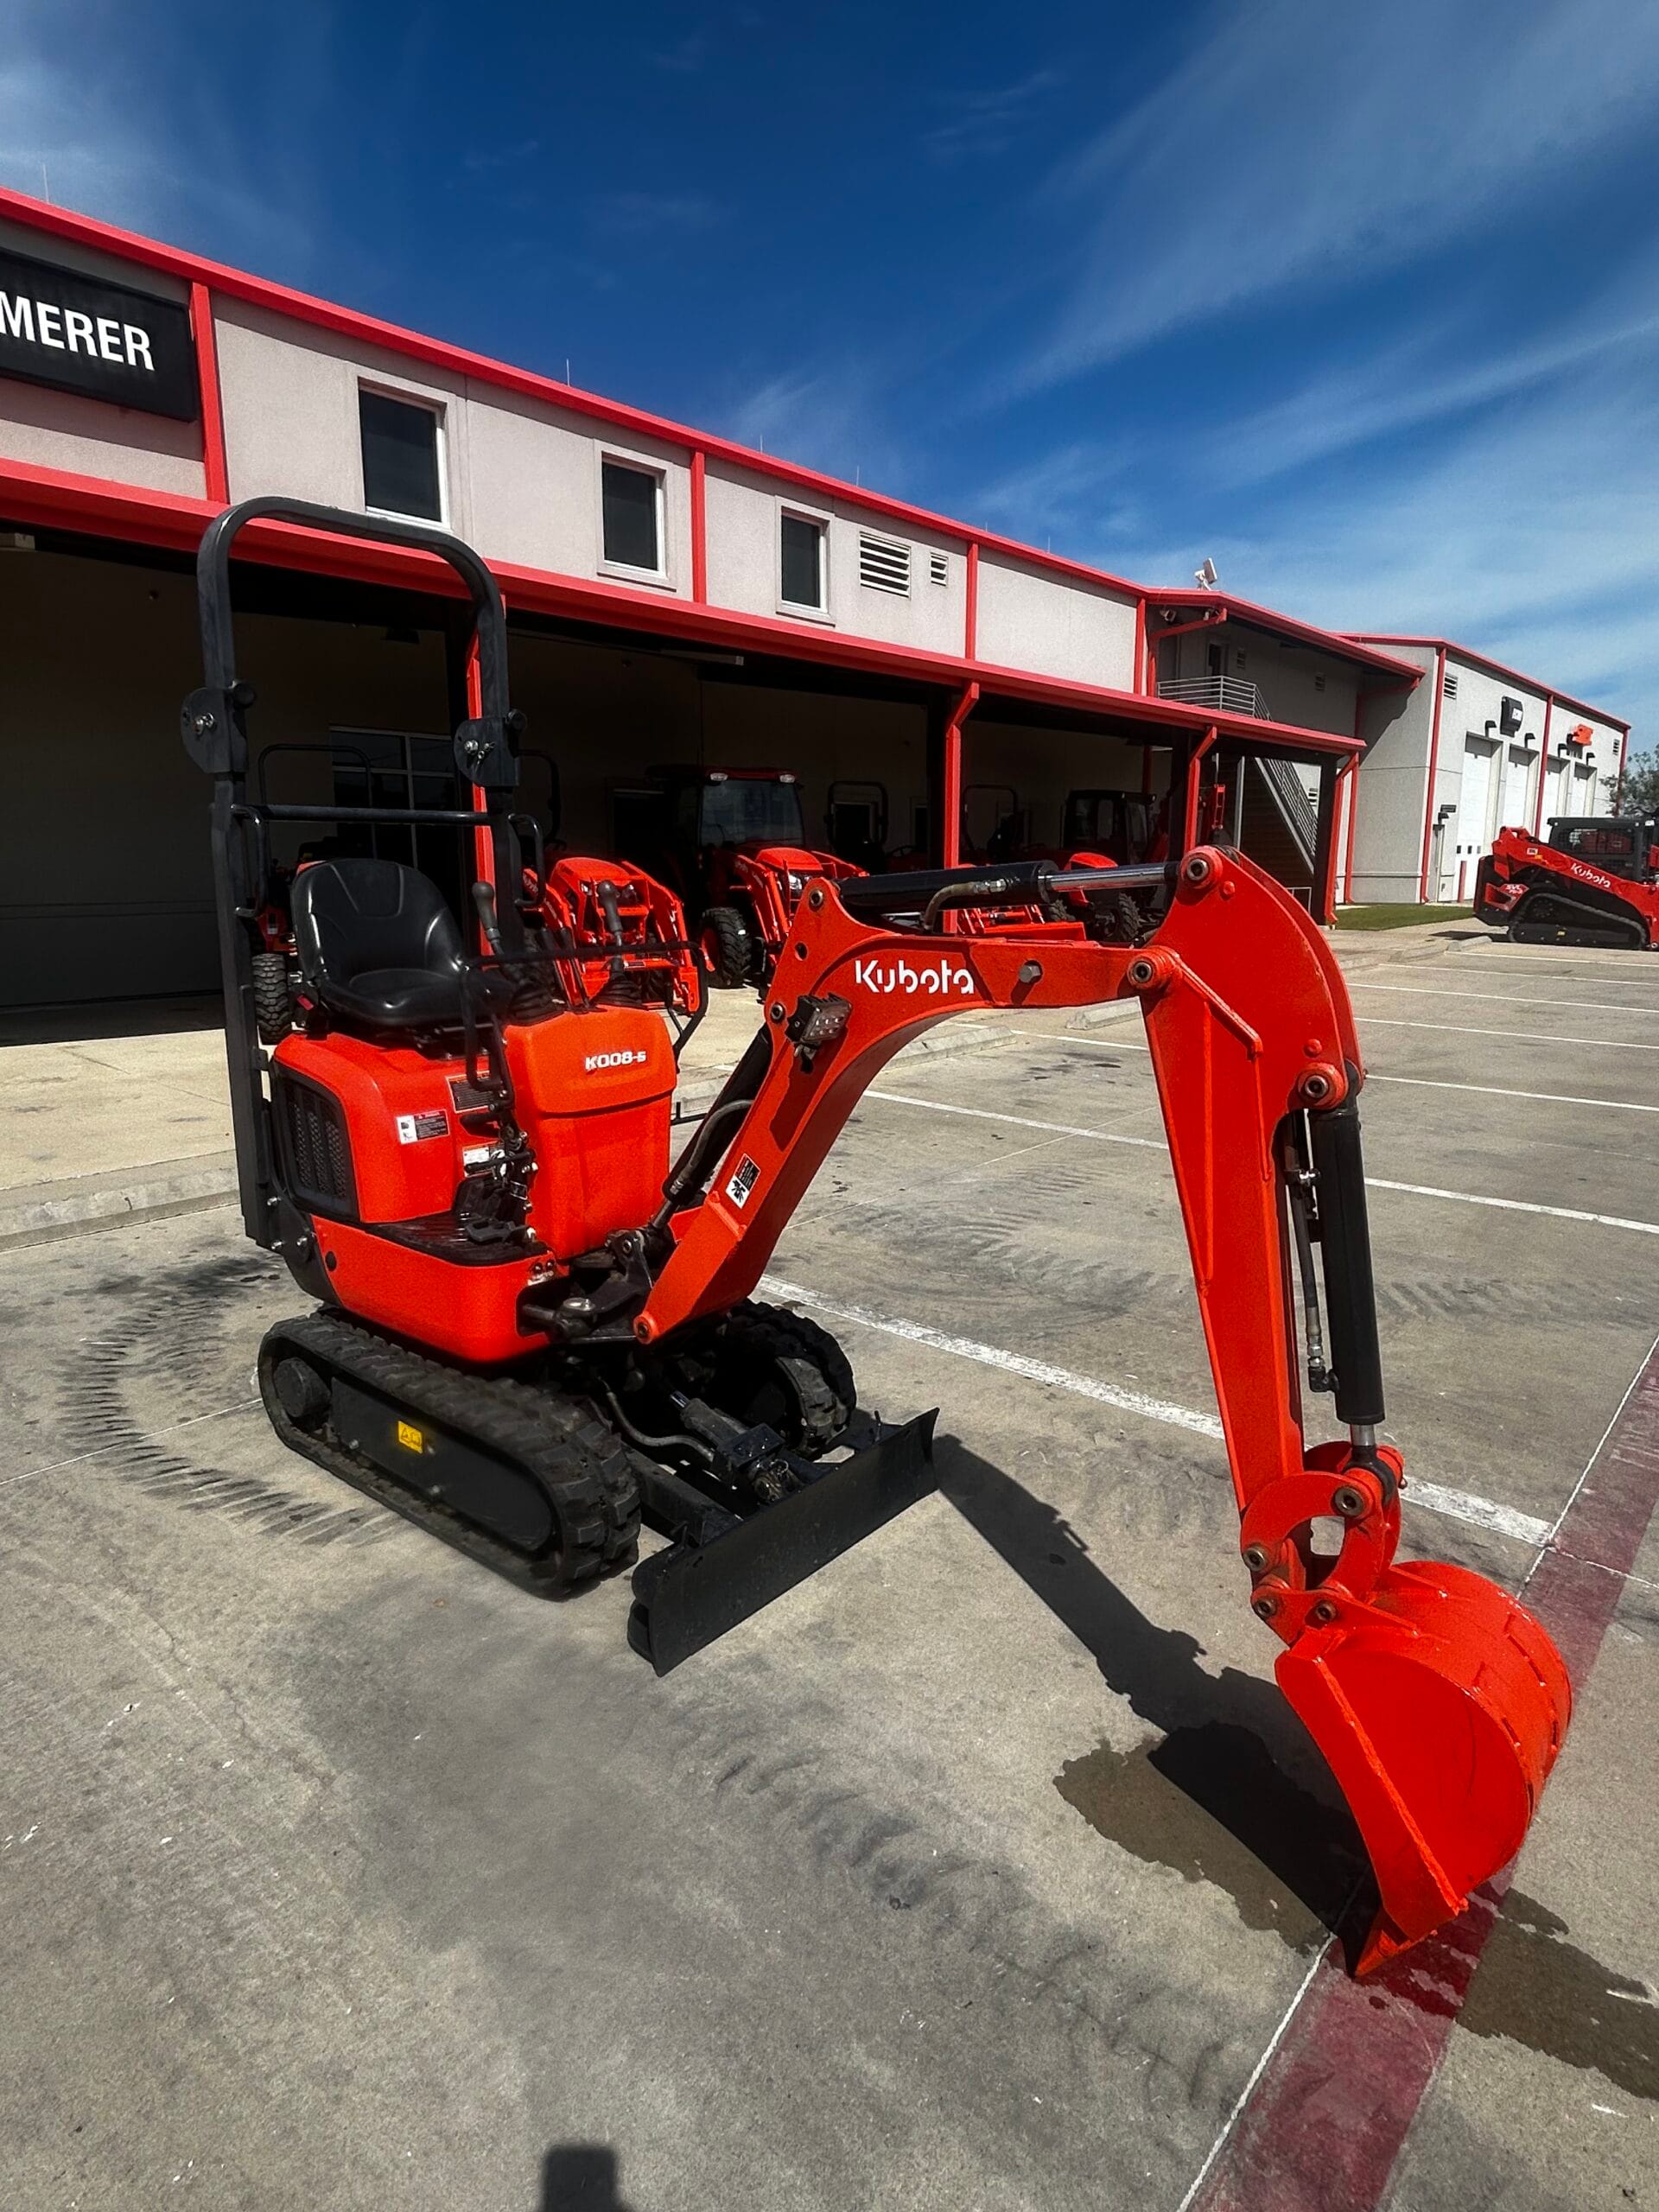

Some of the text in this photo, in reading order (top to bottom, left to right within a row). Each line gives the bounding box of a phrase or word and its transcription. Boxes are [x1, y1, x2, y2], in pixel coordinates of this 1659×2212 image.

[0, 290, 155, 371] MERER
[1570, 862, 1611, 888] Kubota
[855, 959, 974, 994] Kubota
[585, 1051, 646, 1071] K008-5
